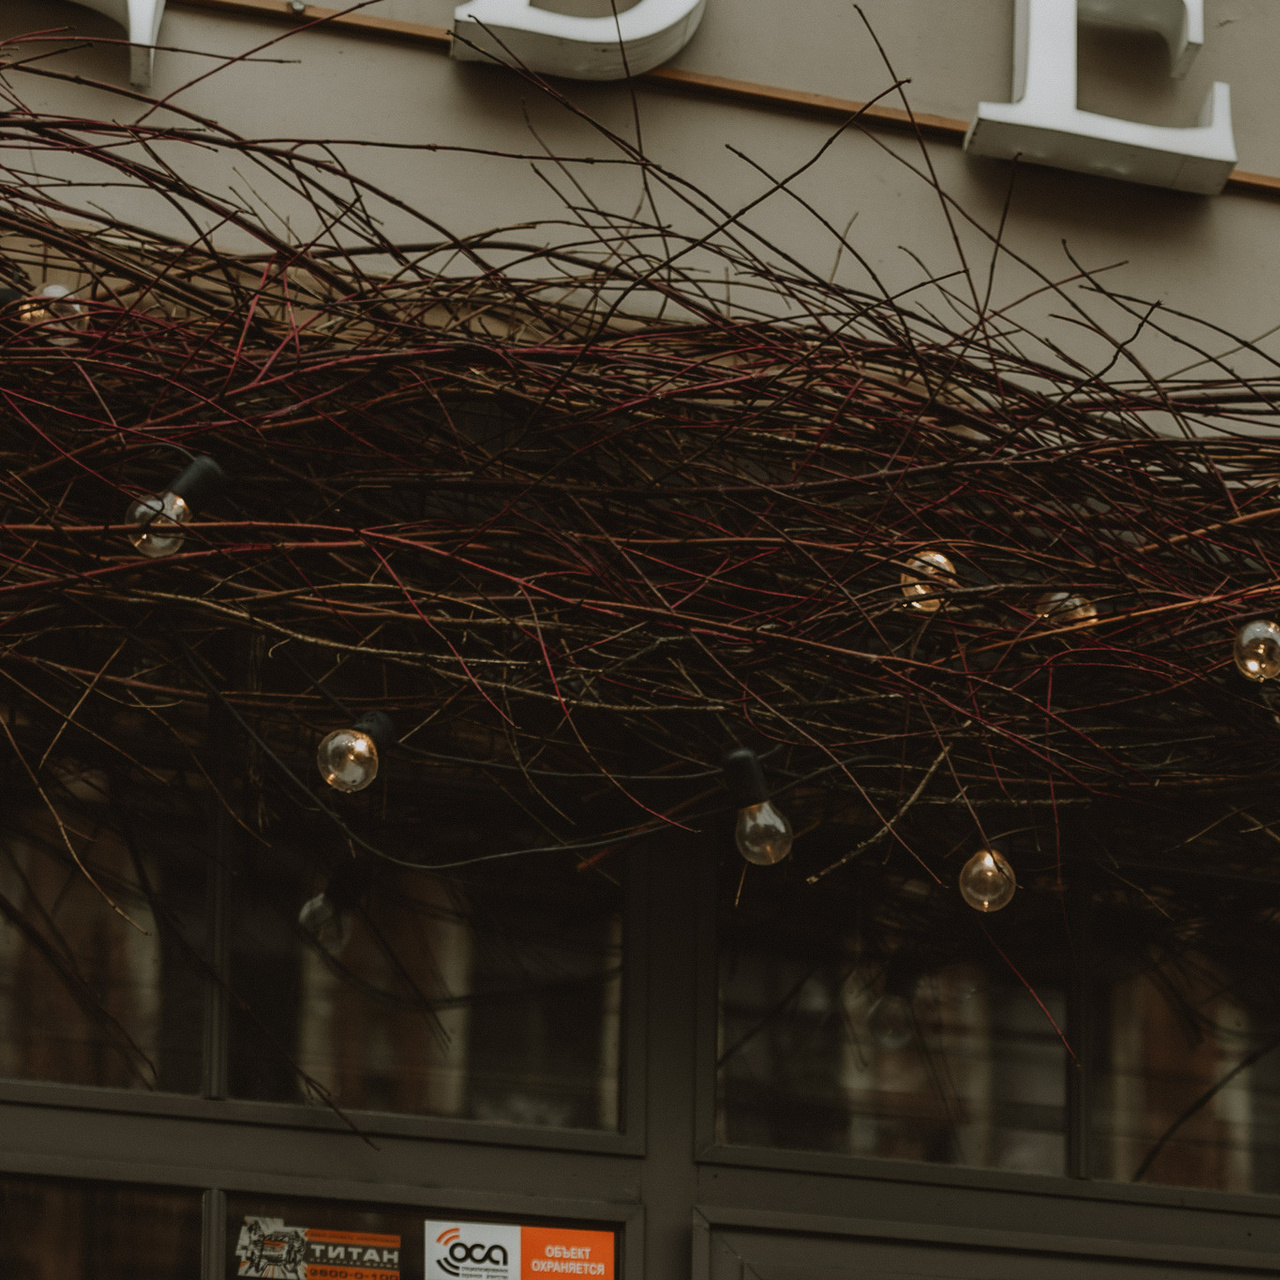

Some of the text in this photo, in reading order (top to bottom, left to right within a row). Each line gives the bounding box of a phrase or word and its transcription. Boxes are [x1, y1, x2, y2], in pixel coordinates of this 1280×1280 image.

[310, 1244, 399, 1263] ТИТАН
[545, 1245, 591, 1260] ОБЪЕКТ
[531, 1260, 605, 1275] ОХРАНЯЕТСЯ
